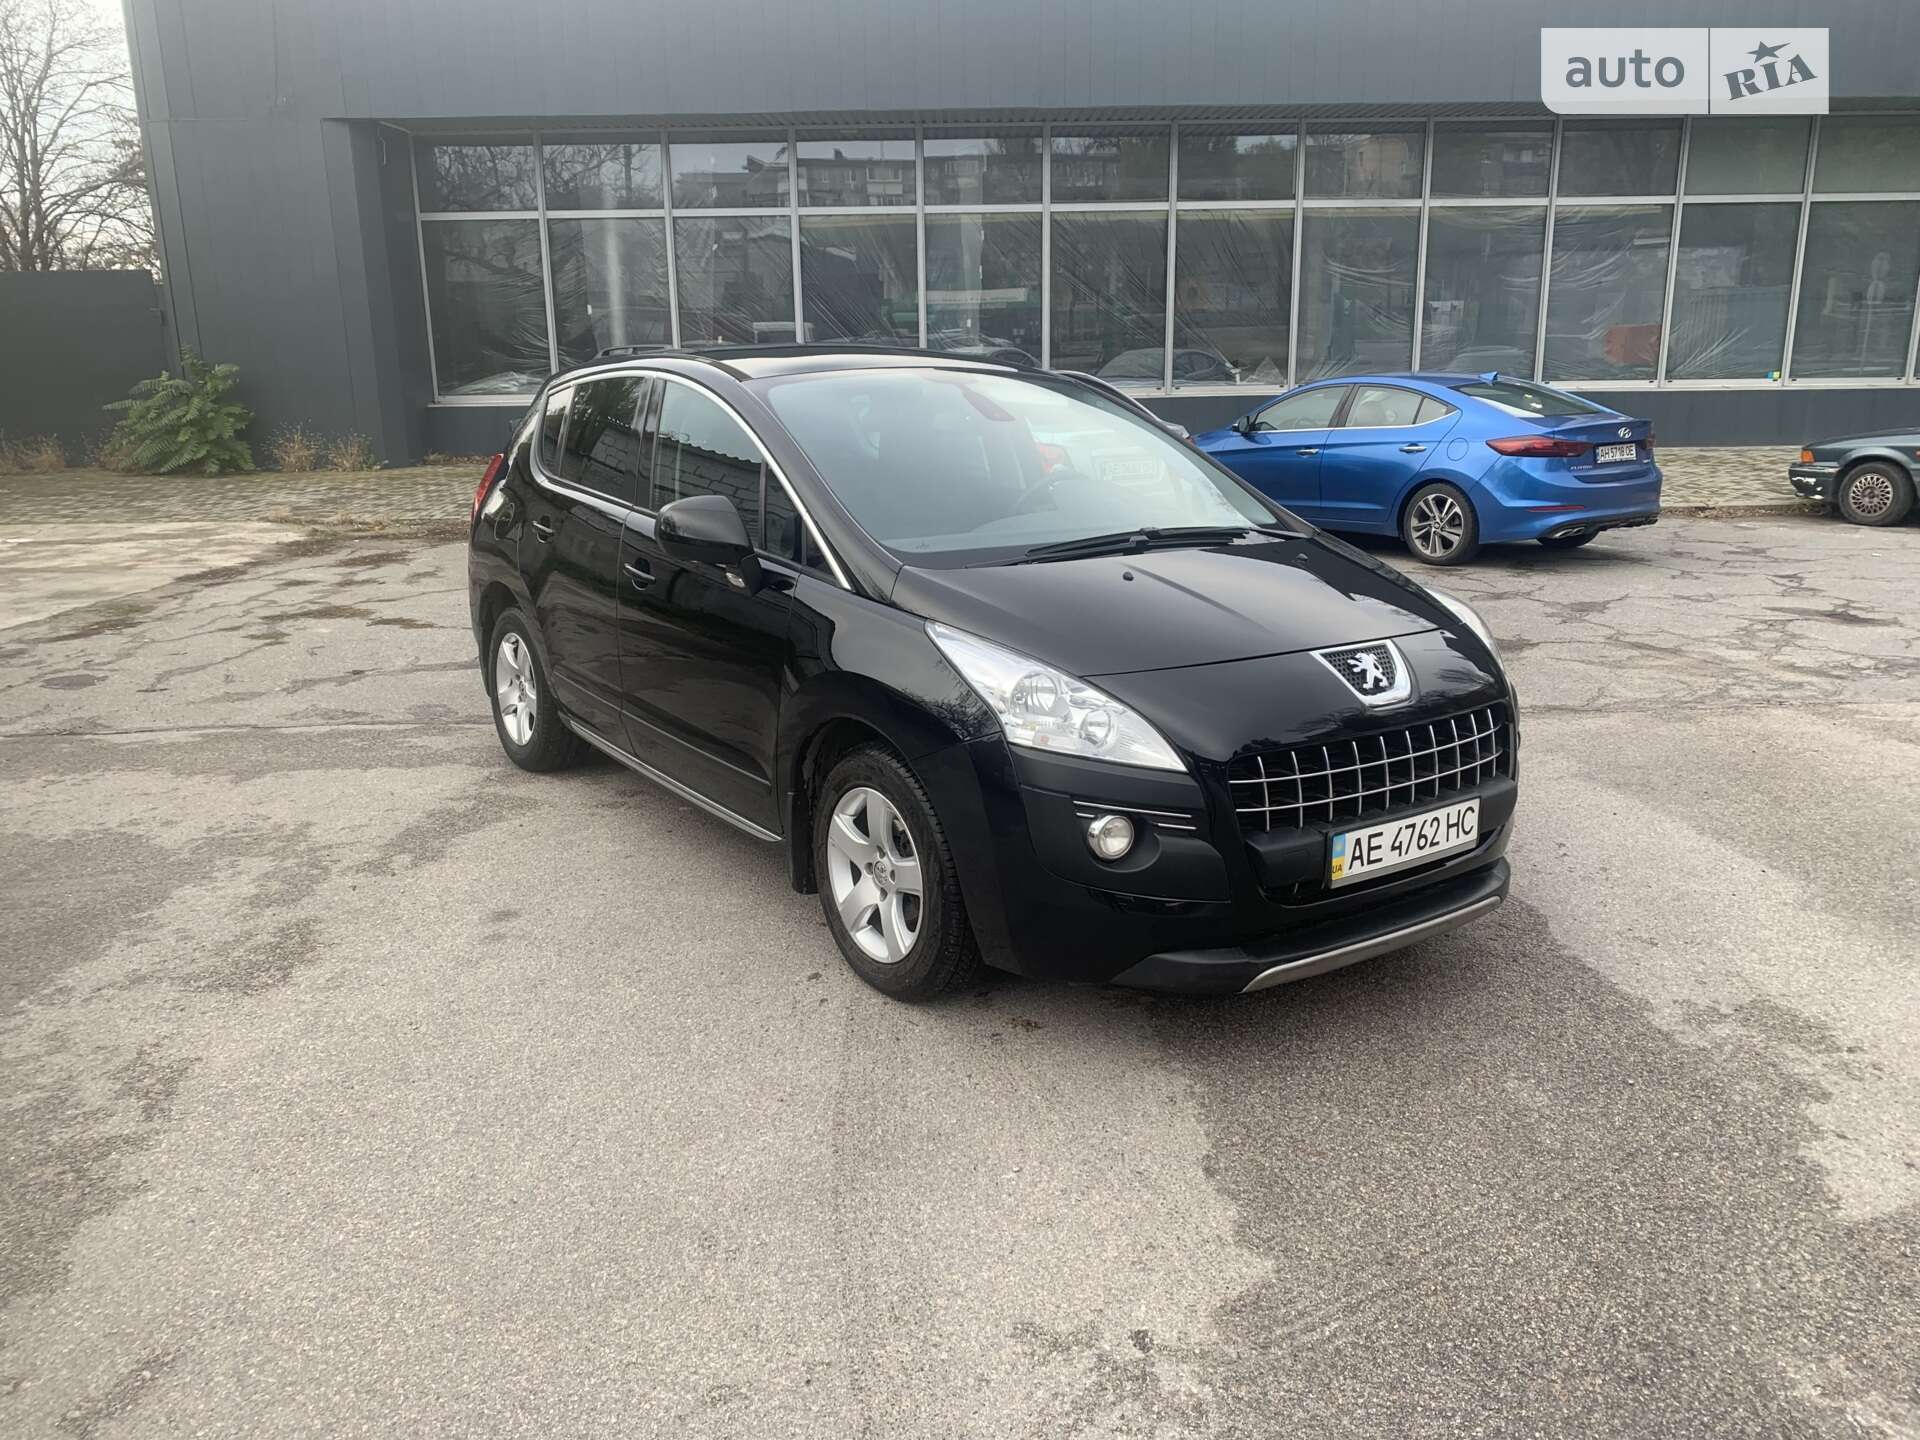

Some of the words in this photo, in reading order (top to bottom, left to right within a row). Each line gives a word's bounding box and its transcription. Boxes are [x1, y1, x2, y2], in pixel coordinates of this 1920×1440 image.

[1349, 831, 1384, 870] AE
[1390, 816, 1440, 857] 4762
[1446, 806, 1475, 842] HC
[1332, 864, 1343, 874] UA
